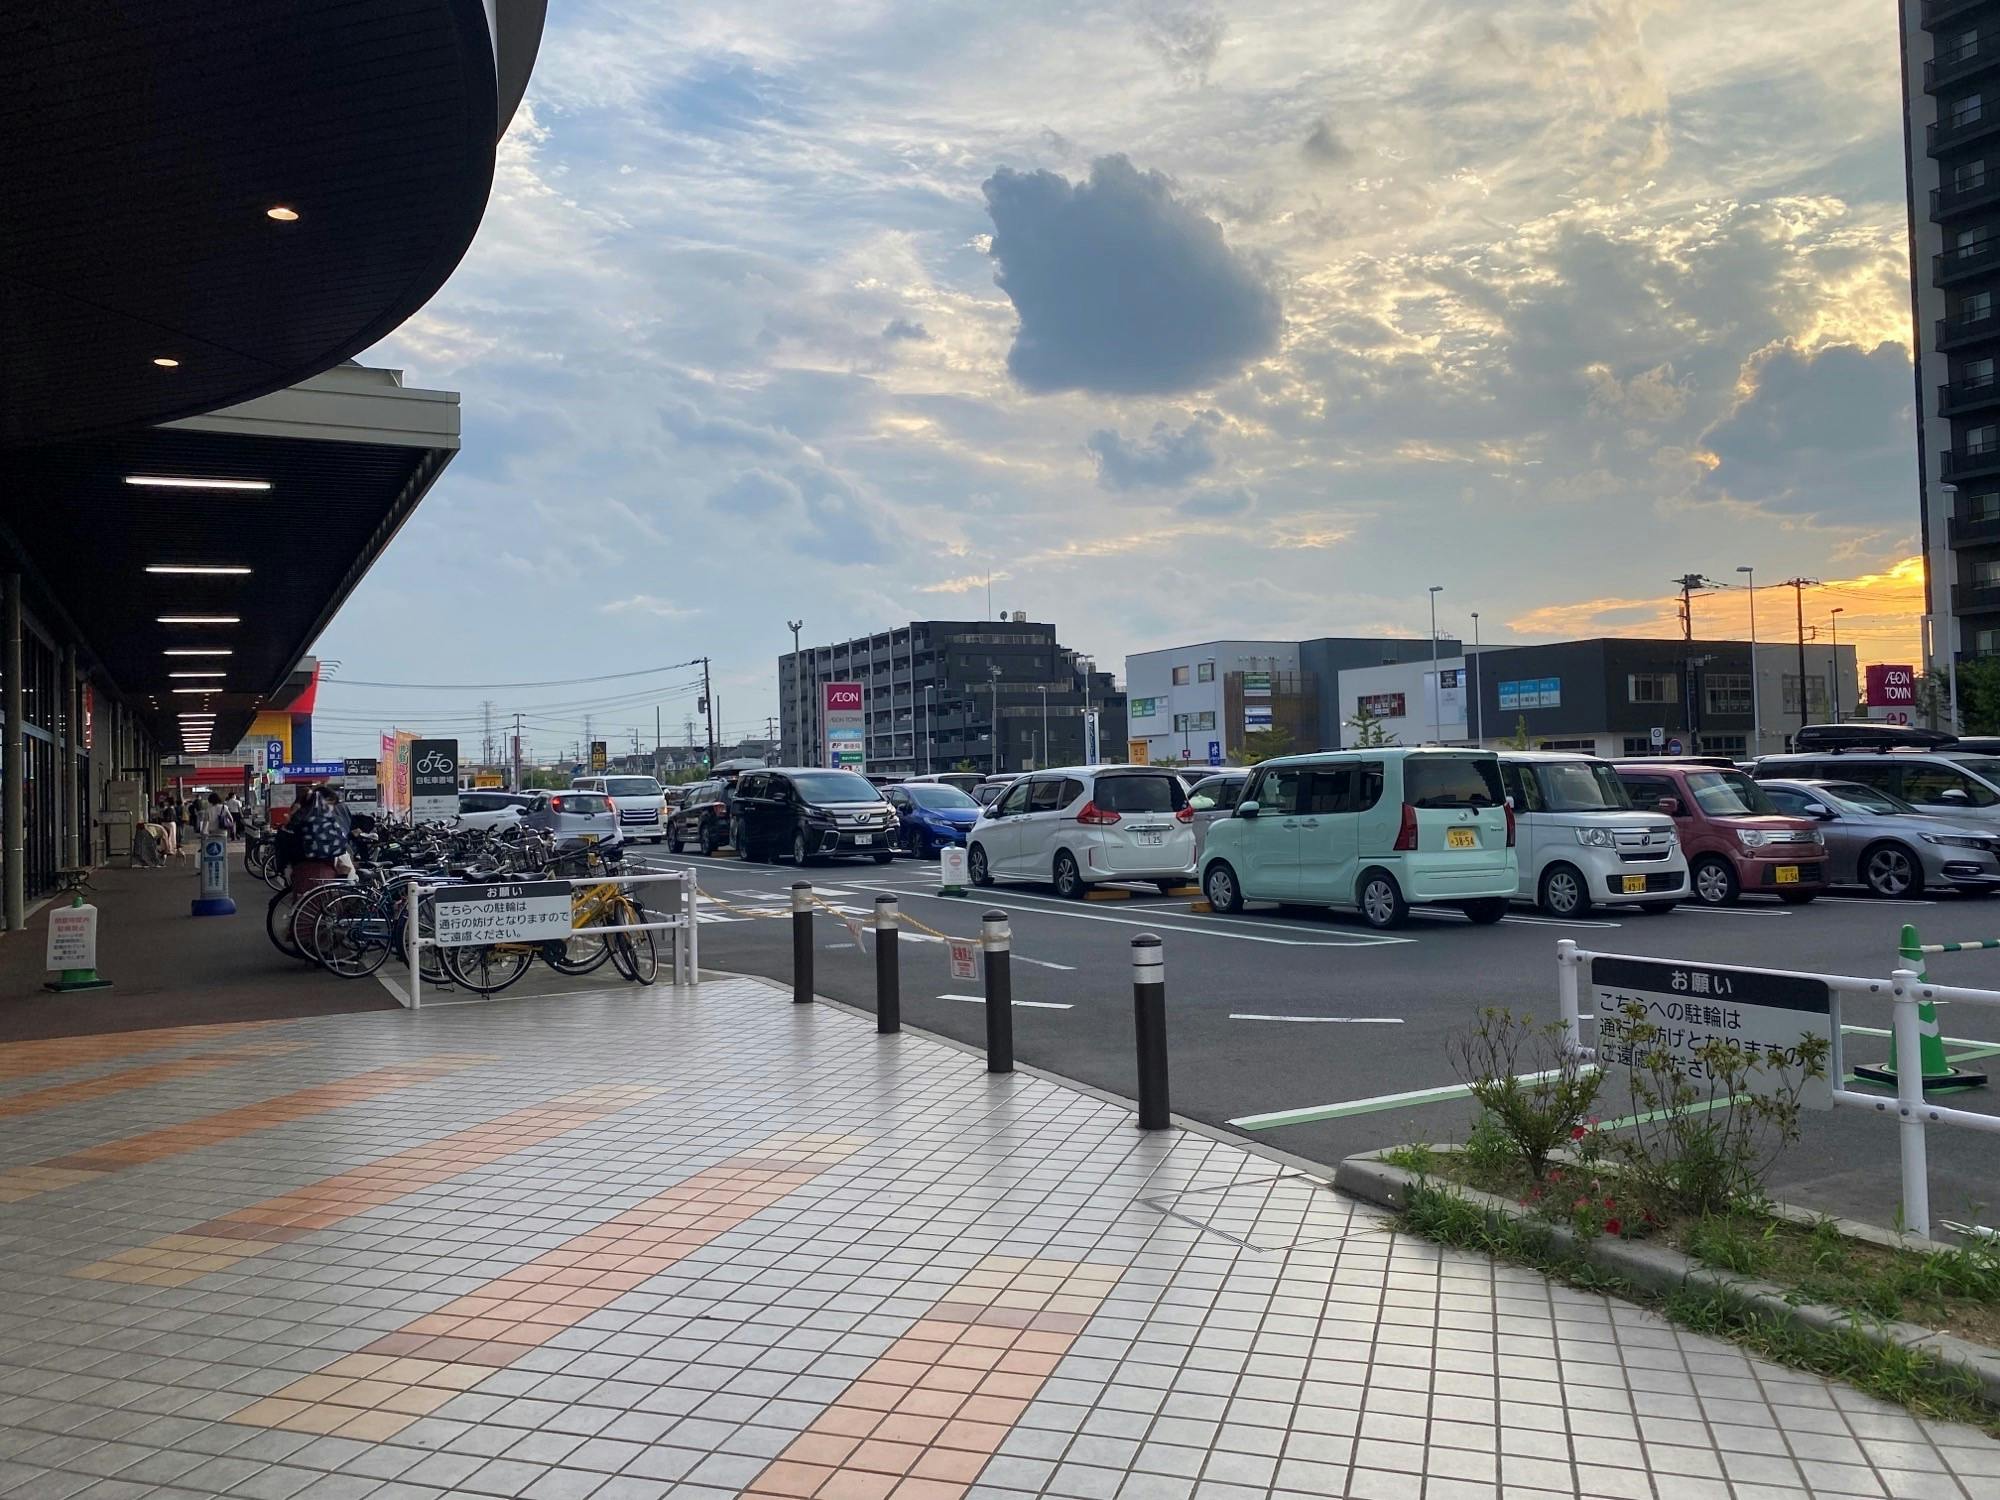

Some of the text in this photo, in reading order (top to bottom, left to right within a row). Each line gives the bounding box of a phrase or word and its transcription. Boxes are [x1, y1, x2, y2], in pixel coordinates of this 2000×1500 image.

[1885, 687, 1911, 699] TOWN
[272, 760, 280, 768] P
[415, 775, 455, 785] 自転車置場
[486, 886, 523, 898] お願い
[439, 902, 528, 917] こちらへの駐輪は
[439, 912, 569, 930] 通行の妨げとなりますので
[439, 929, 521, 943] ご遠慮ください。
[1671, 969, 1732, 995] お願い
[1601, 992, 1742, 1030] こちらへの駐輪は
